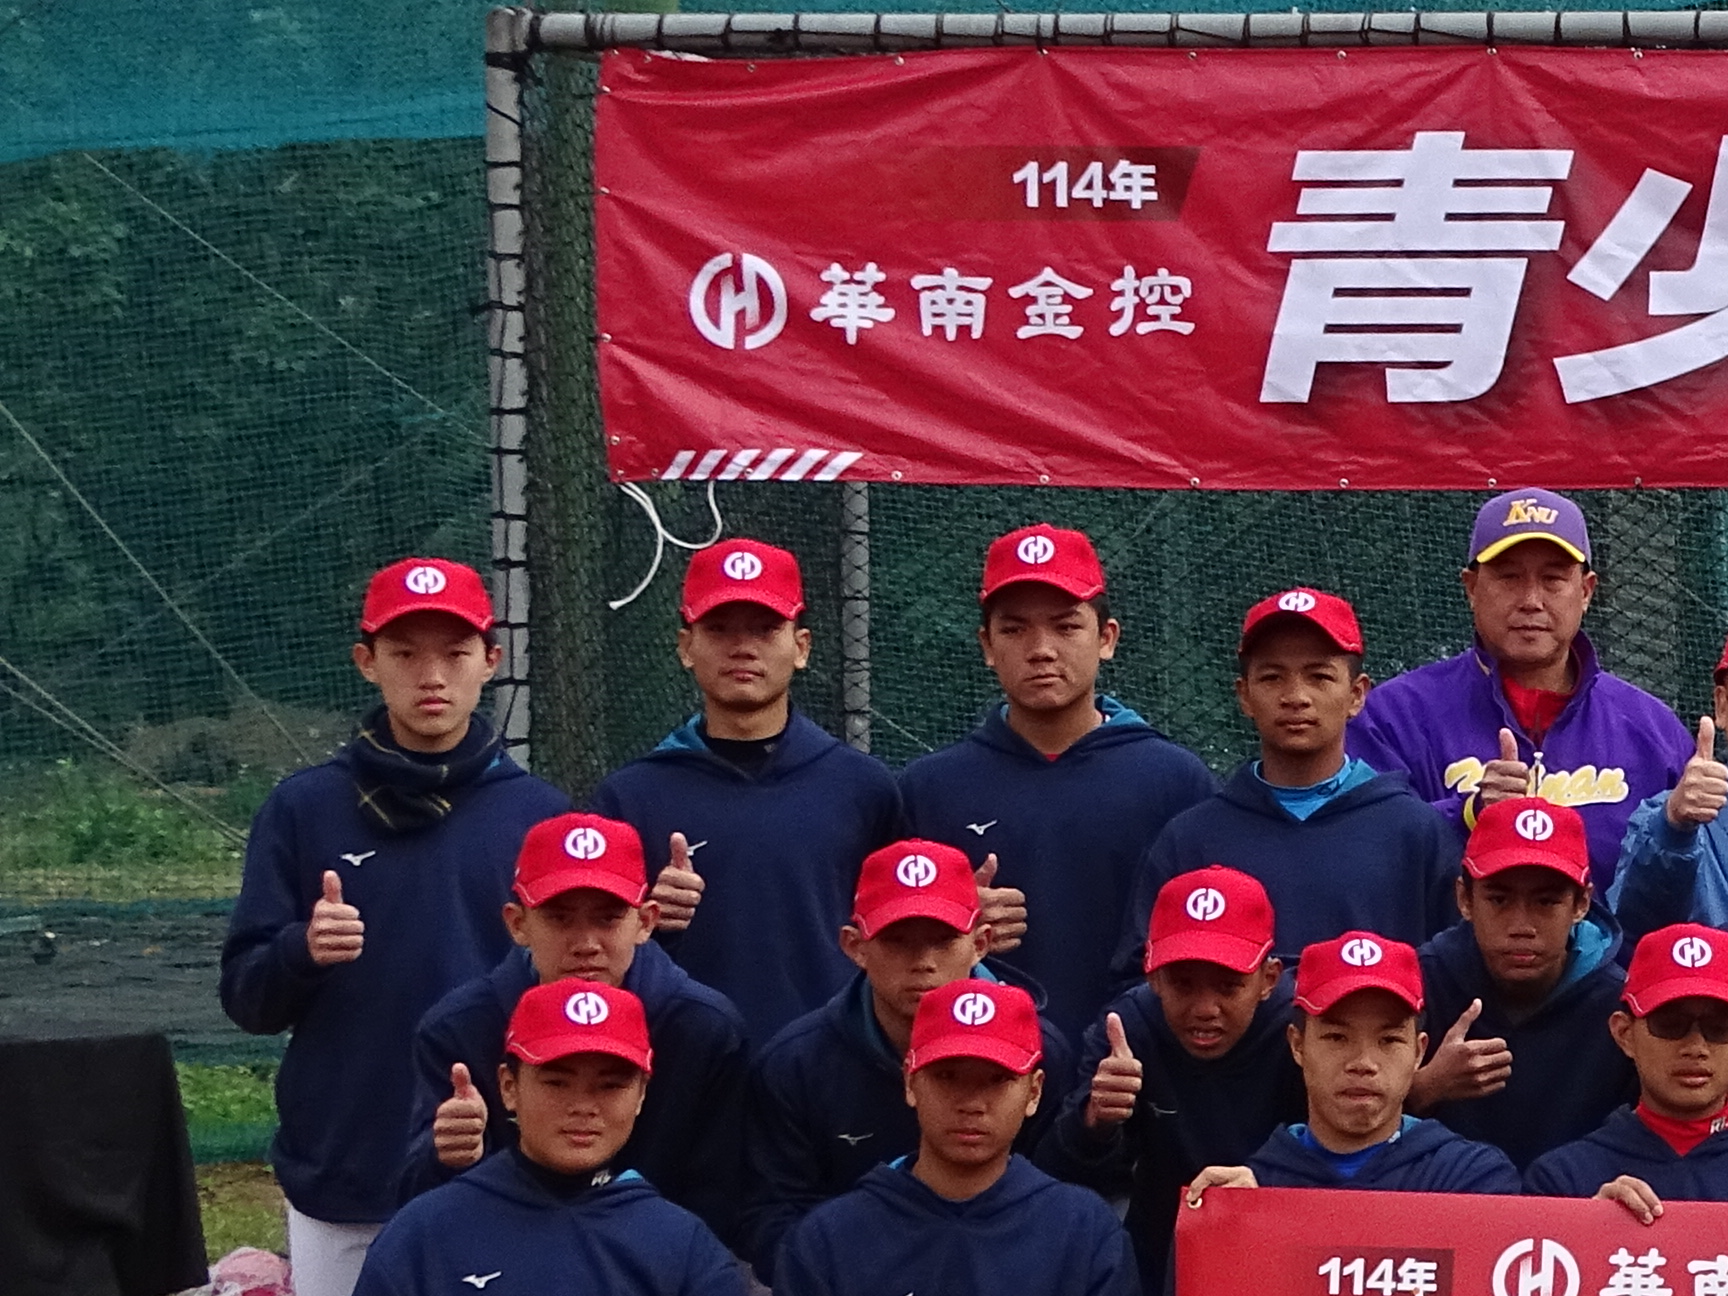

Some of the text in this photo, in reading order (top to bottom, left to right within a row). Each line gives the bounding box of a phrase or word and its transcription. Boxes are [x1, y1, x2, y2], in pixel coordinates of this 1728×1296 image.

[1012, 159, 1158, 210] 114年
[809, 262, 1195, 345] 華南金控
[1502, 498, 1559, 526] KNU
